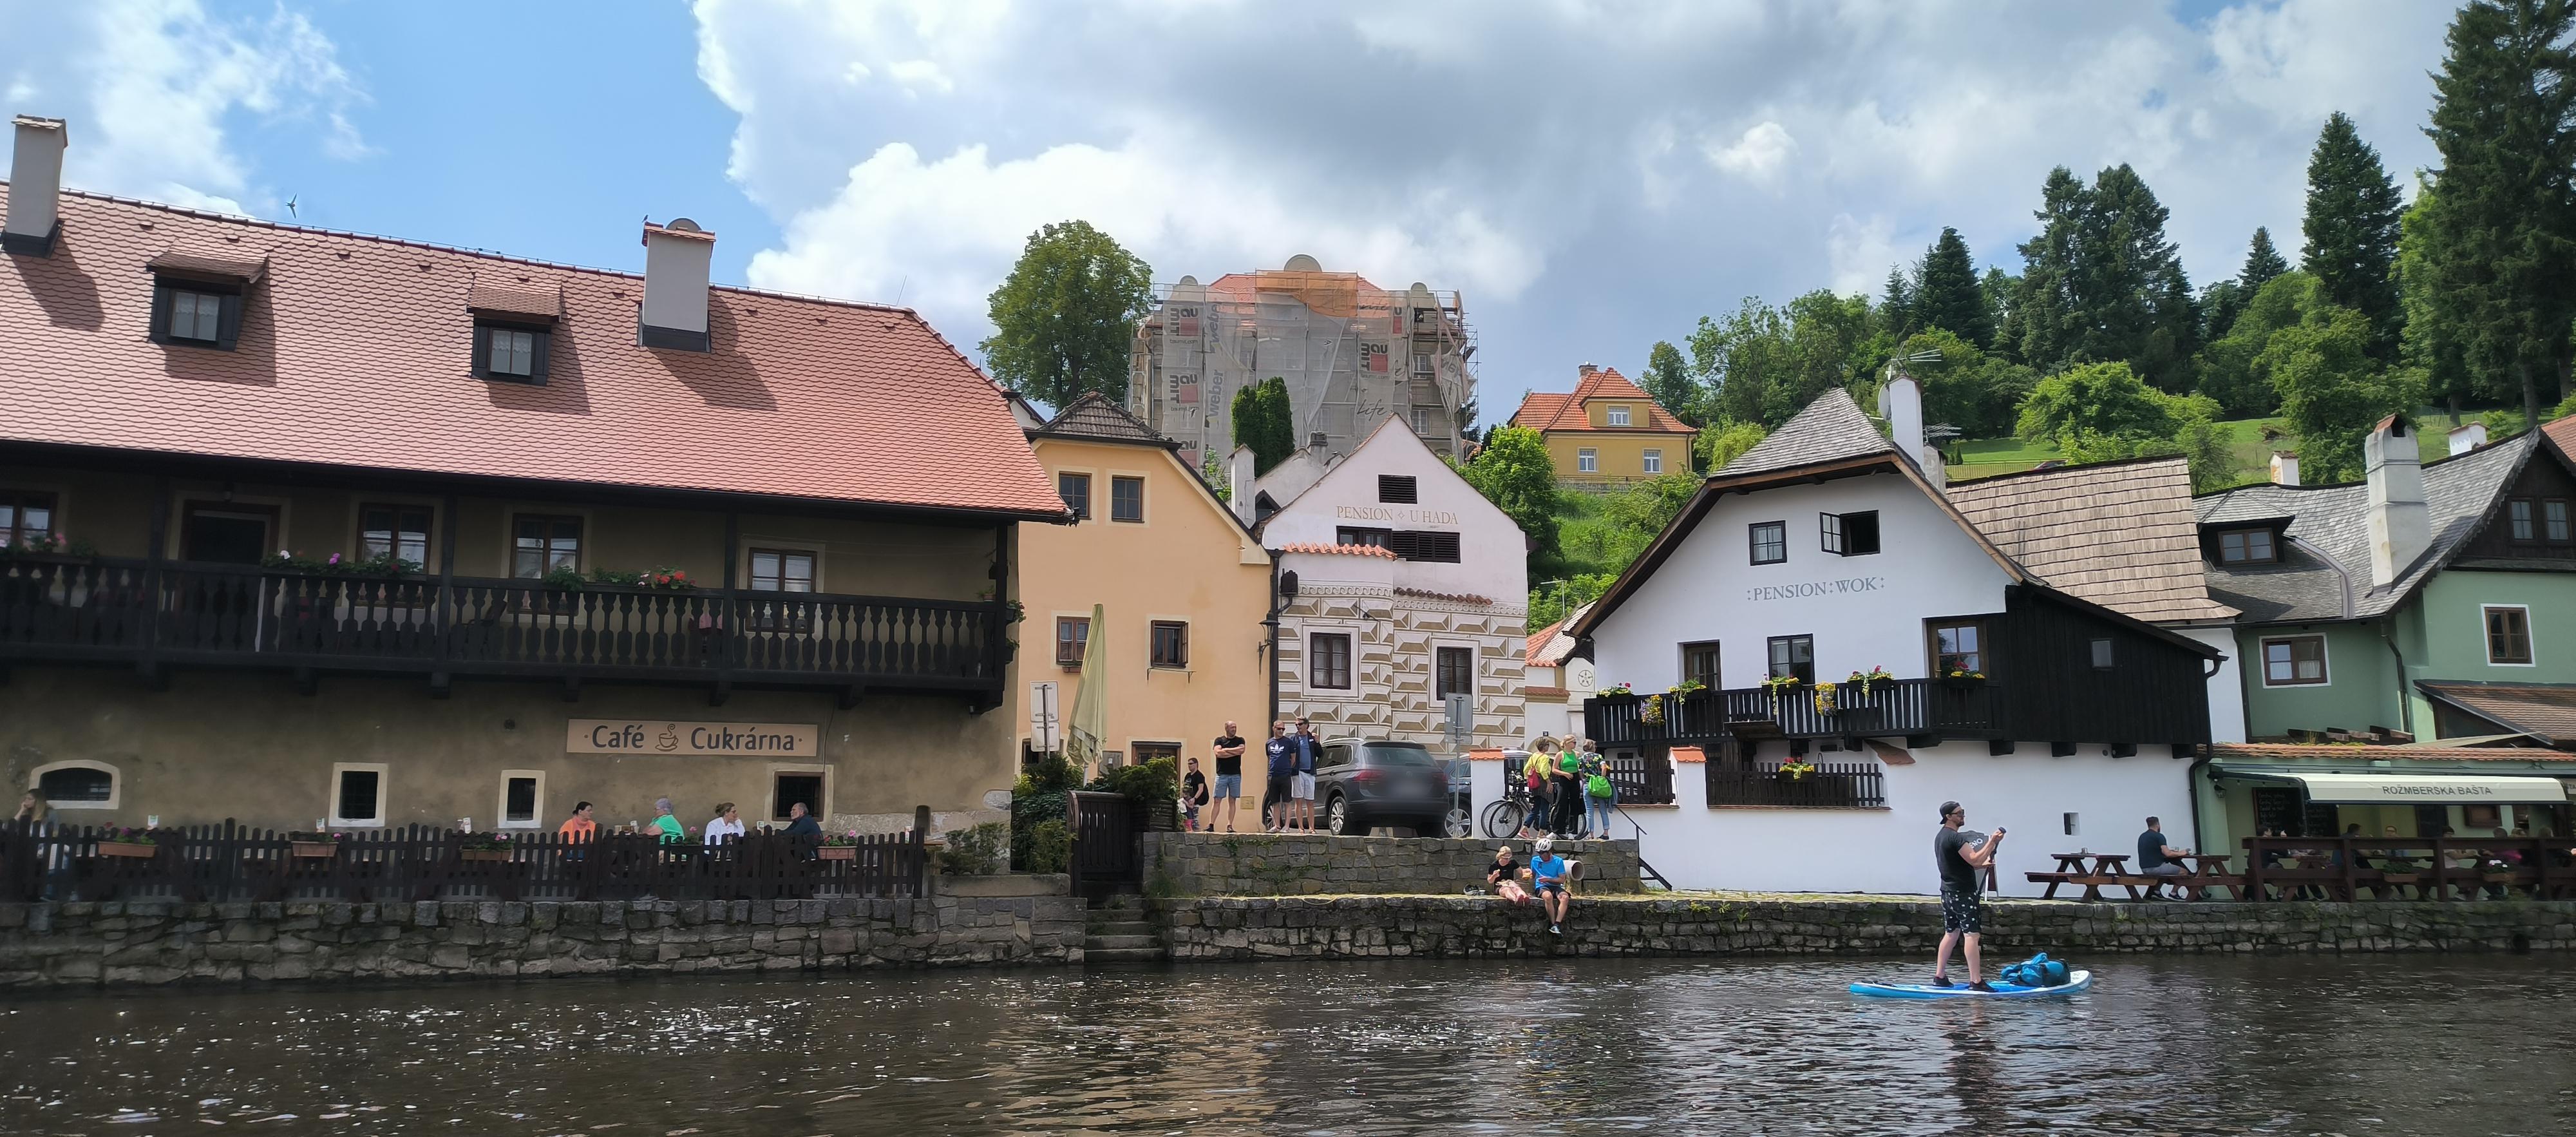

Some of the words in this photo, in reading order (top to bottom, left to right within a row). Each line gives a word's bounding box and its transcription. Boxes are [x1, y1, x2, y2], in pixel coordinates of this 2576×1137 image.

[1208, 369, 1224, 417] weber
[1336, 506, 1393, 521] PENSION
[1410, 510, 1418, 522] U
[1423, 511, 1458, 524] HADA
[1754, 582, 1826, 601] PENSION
[1835, 577, 1877, 593] WOK
[592, 725, 644, 749] Café
[691, 727, 795, 751] Cukrárna
[2382, 784, 2456, 795] ROŽMBERSKÁ
[2458, 784, 2492, 795] BAŠTA
